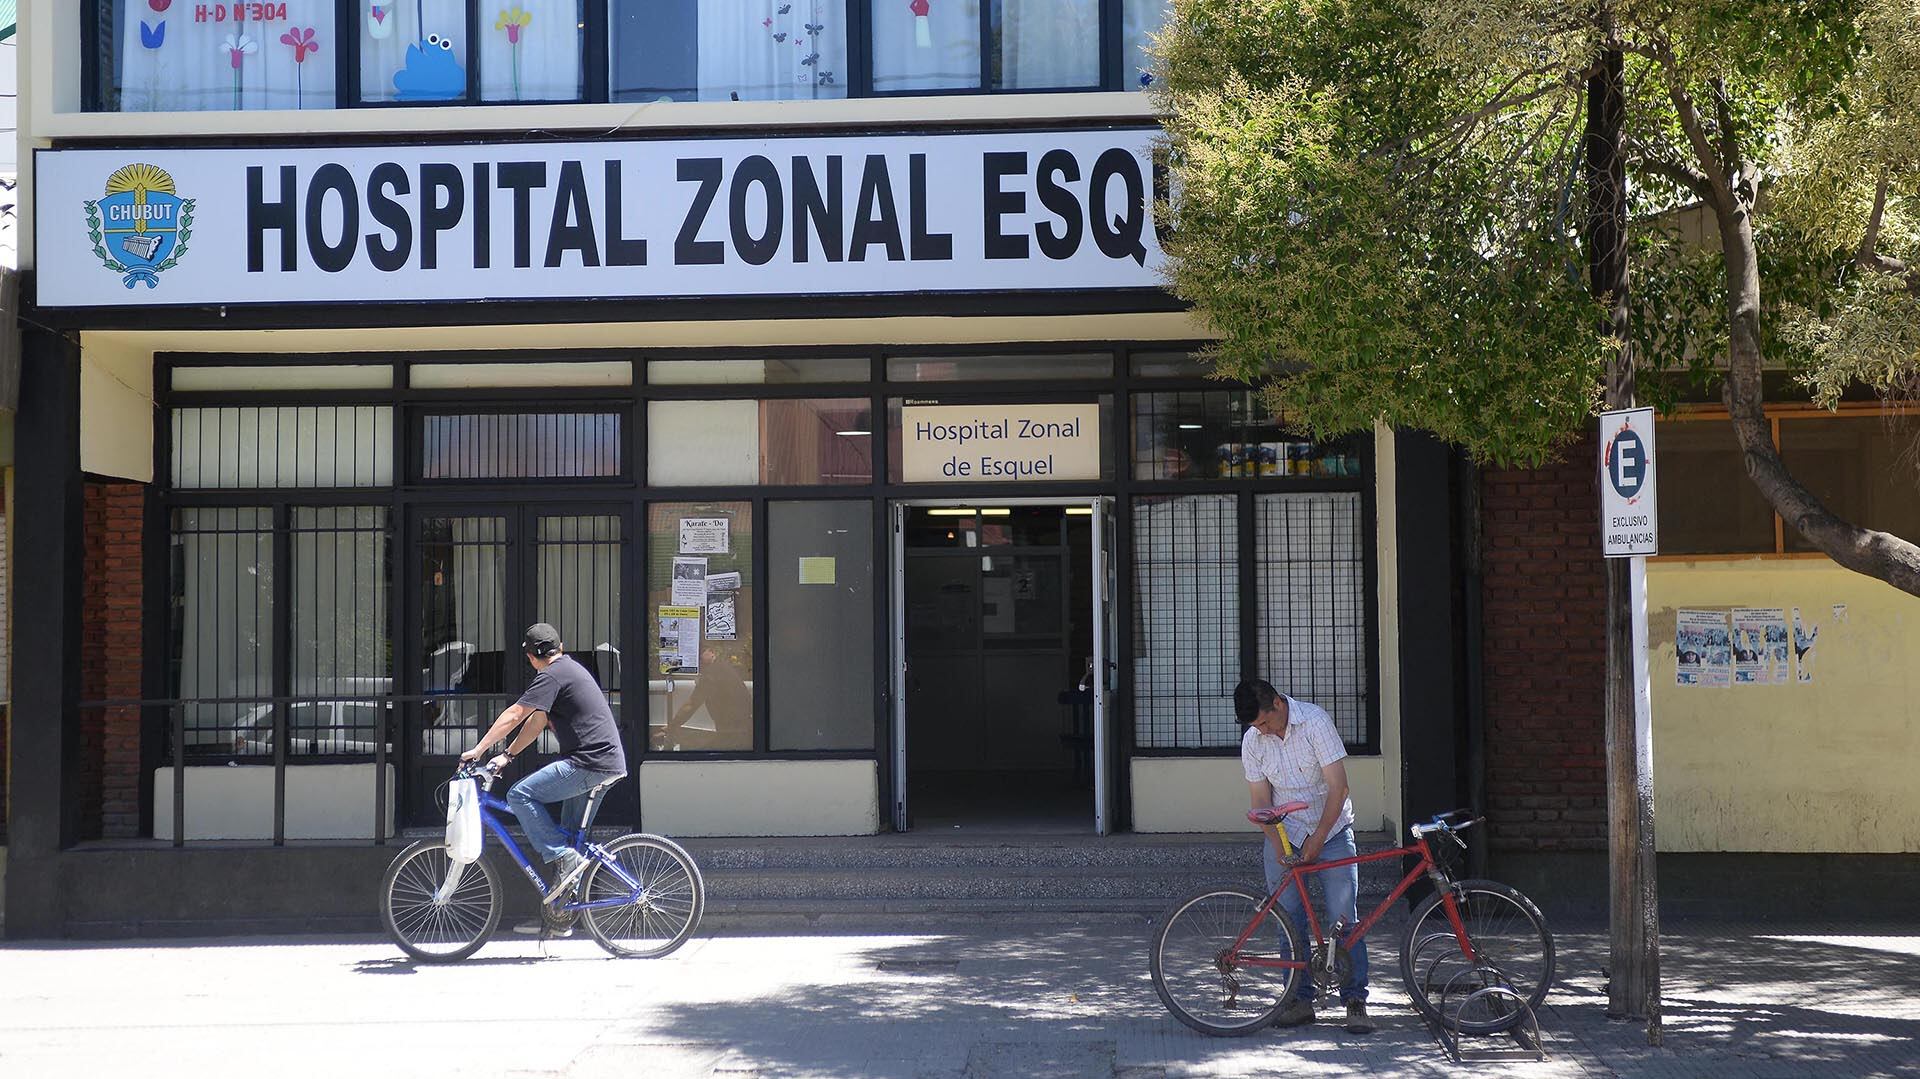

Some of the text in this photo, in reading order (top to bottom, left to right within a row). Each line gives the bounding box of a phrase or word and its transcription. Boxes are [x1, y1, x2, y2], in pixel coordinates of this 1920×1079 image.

[195, 4, 226, 22] H-D
[109, 204, 173, 221] CHUBUT
[247, 160, 648, 273] HOSPITAL
[674, 153, 954, 266] ZONAL
[916, 416, 1080, 445] Hospital Zonal
[942, 454, 1053, 480] de Esquel
[1617, 439, 1638, 487] E
[1612, 515, 1648, 528] EXCLUSIVO
[1607, 532, 1654, 545] AMBULANCIAS
